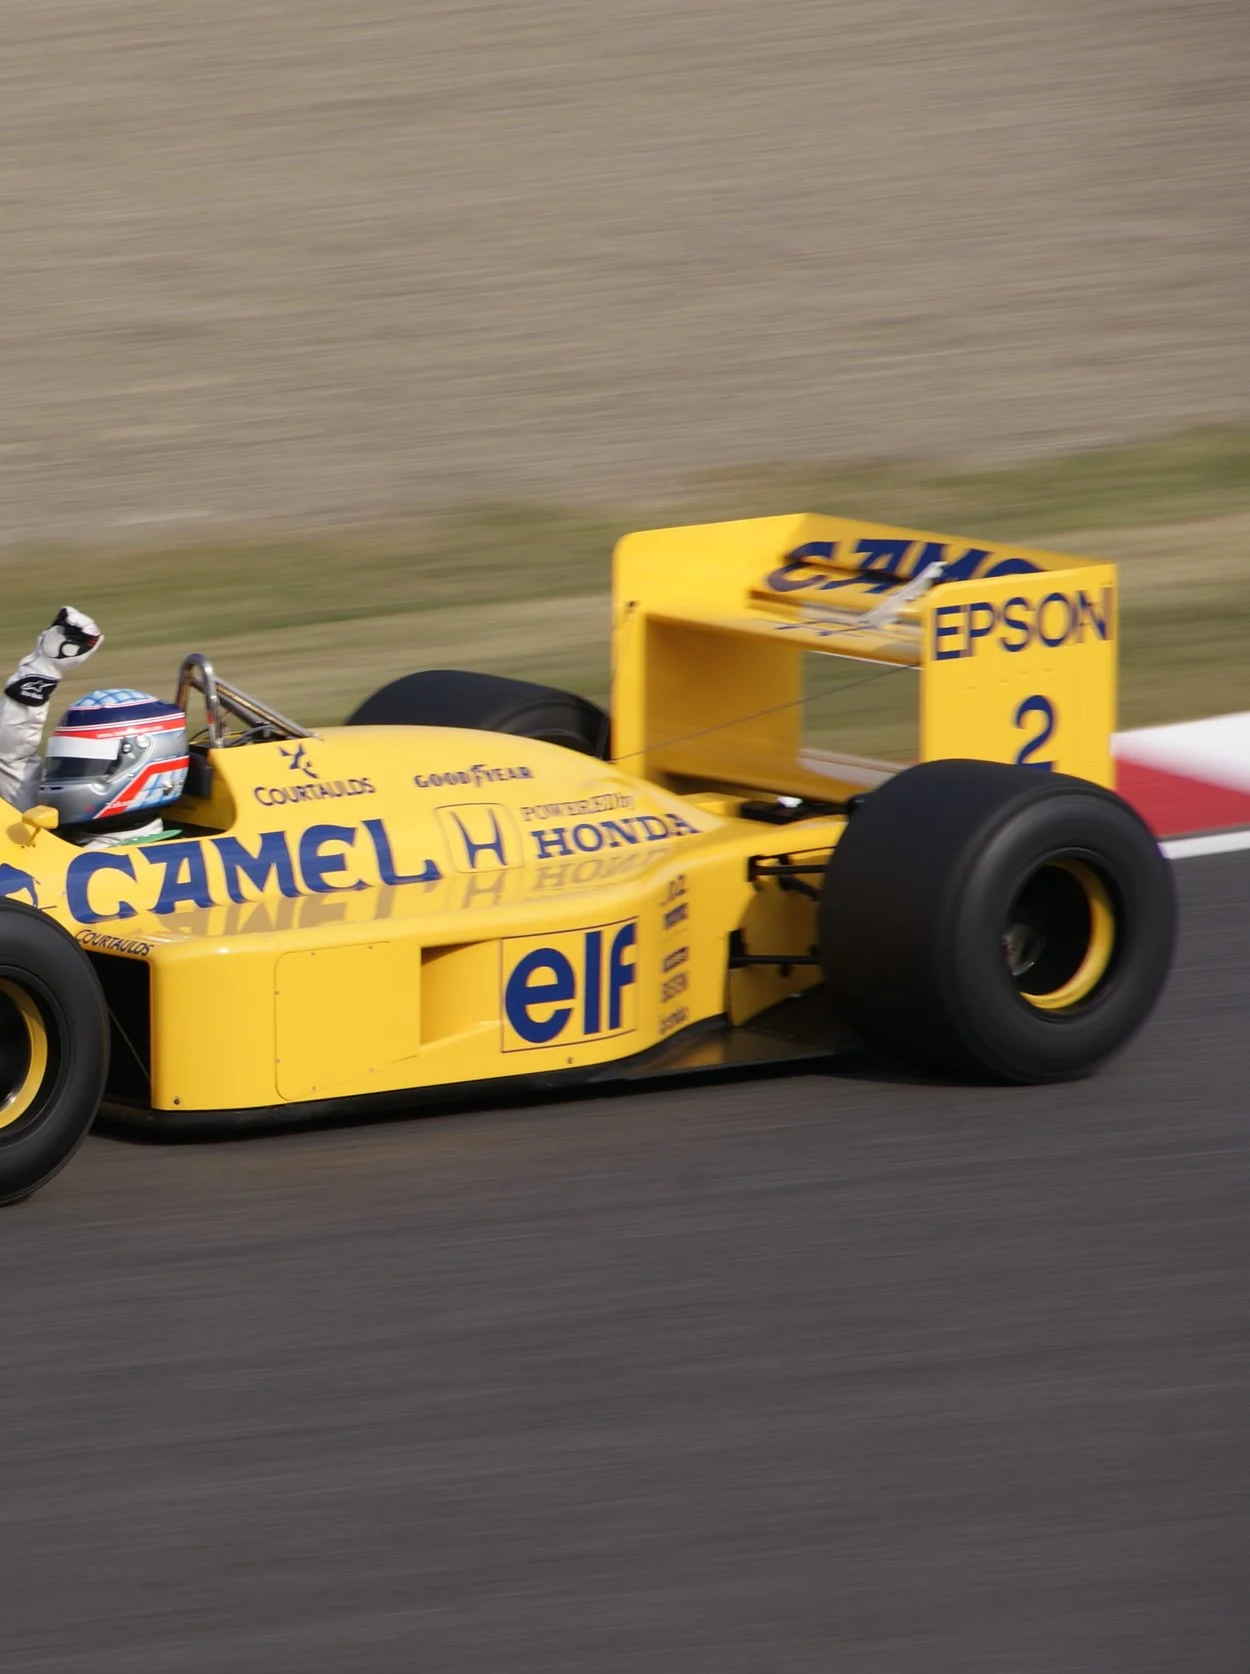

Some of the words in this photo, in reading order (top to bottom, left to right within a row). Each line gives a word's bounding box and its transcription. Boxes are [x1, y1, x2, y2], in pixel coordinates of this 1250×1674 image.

[765, 538, 1048, 594] CAM
[934, 586, 1113, 662] EPSON
[1014, 694, 1058, 769] 2
[253, 777, 377, 807] COURTAULDS
[520, 792, 618, 821] POWERED
[530, 813, 702, 860] HONDA
[64, 818, 442, 925] CAMEL
[74, 929, 155, 956] COURTAULDS
[504, 922, 638, 1044] elf
